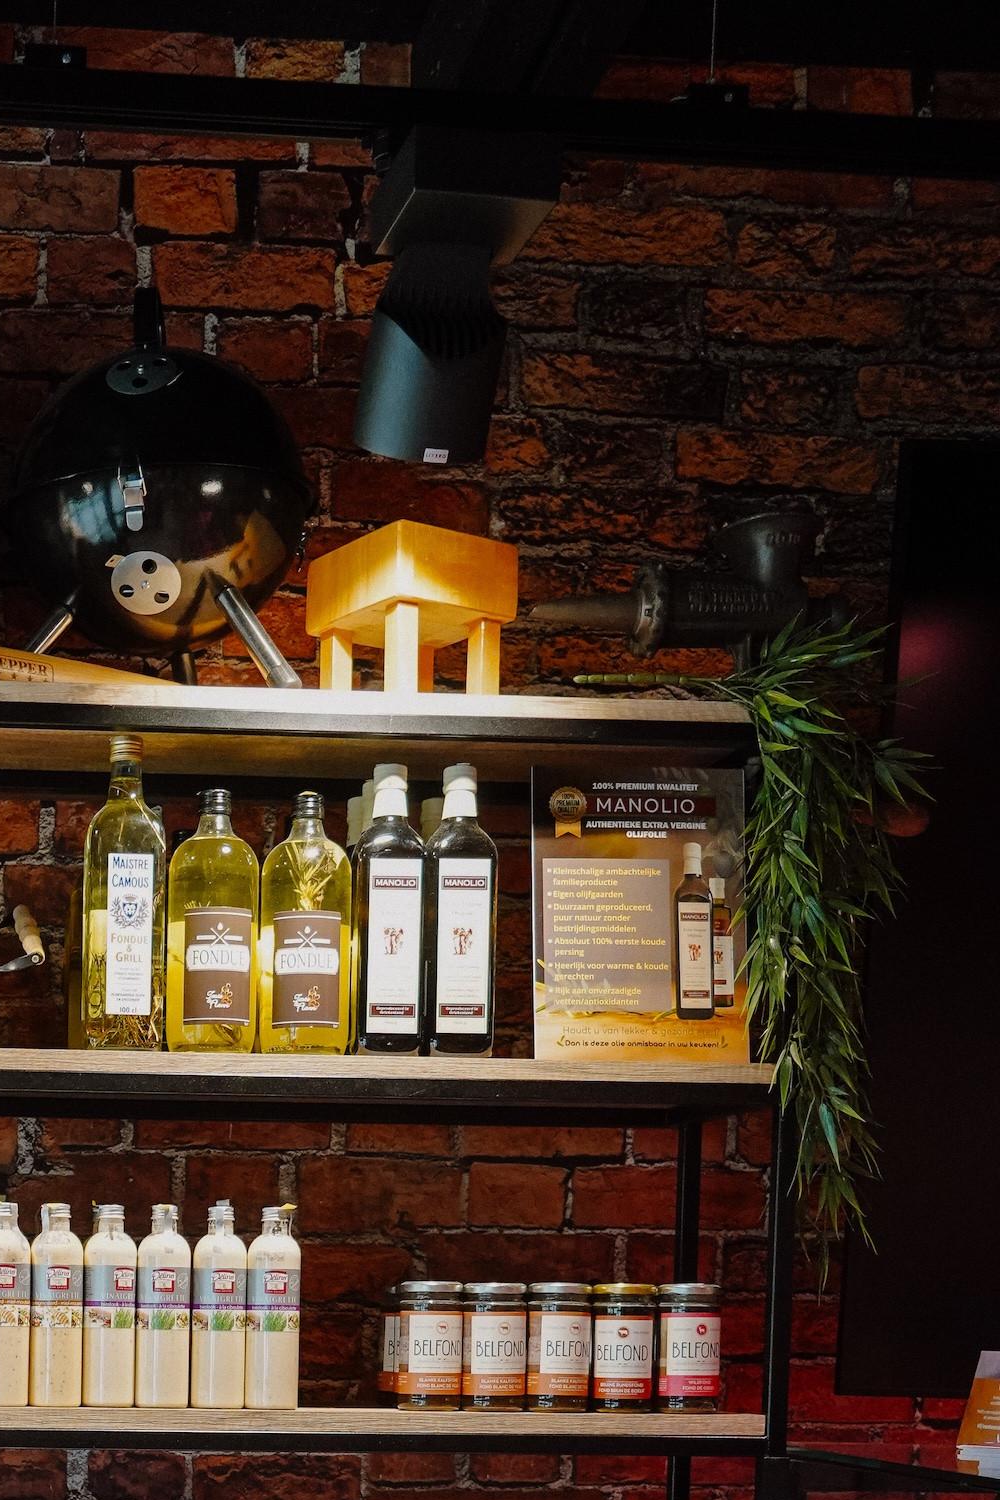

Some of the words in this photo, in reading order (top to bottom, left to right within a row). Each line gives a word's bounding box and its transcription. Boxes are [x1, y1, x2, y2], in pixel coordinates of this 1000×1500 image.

[616, 783, 656, 791] PREMIUM
[656, 783, 699, 791] KWALITEIT
[596, 798, 695, 814] MANOLIO
[586, 821, 641, 829] AUTHENTIEKE
[671, 822, 707, 830] VERGINE
[112, 856, 149, 869] MAISTRE
[553, 868, 604, 877] Kleinschalige
[606, 868, 661, 877] ambachtelijke
[112, 874, 149, 888] CAMOUS
[375, 878, 416, 887] MANOLIO
[444, 878, 485, 887] MANOLIO
[553, 878, 618, 887] familieproductie
[553, 891, 575, 899] Eigen
[576, 890, 623, 899] olijfgaarden
[553, 903, 594, 911] Duurzaam
[596, 904, 653, 913] geproduceerd,
[554, 915, 572, 923] puur
[604, 914, 631, 922] zonder
[111, 933, 148, 944] FONDUE
[554, 937, 590, 945] Absoluut
[592, 937, 613, 945] 100%
[641, 938, 666, 946] koude
[554, 948, 584, 957] persing
[116, 952, 143, 963] GRILL
[193, 950, 245, 966] FONDUE
[281, 953, 333, 969] FONDUE
[554, 962, 585, 971] Heerlijk
[554, 973, 594, 982] gerechten
[565, 1039, 581, 1047] Dan
[627, 1040, 666, 1048] onmisbaar
[689, 1040, 720, 1048] keuken!
[414, 1339, 461, 1356] BELFOND
[476, 1341, 524, 1357] BELFOND
[546, 1340, 590, 1357] BELFON
[597, 1345, 648, 1361] BELFOND
